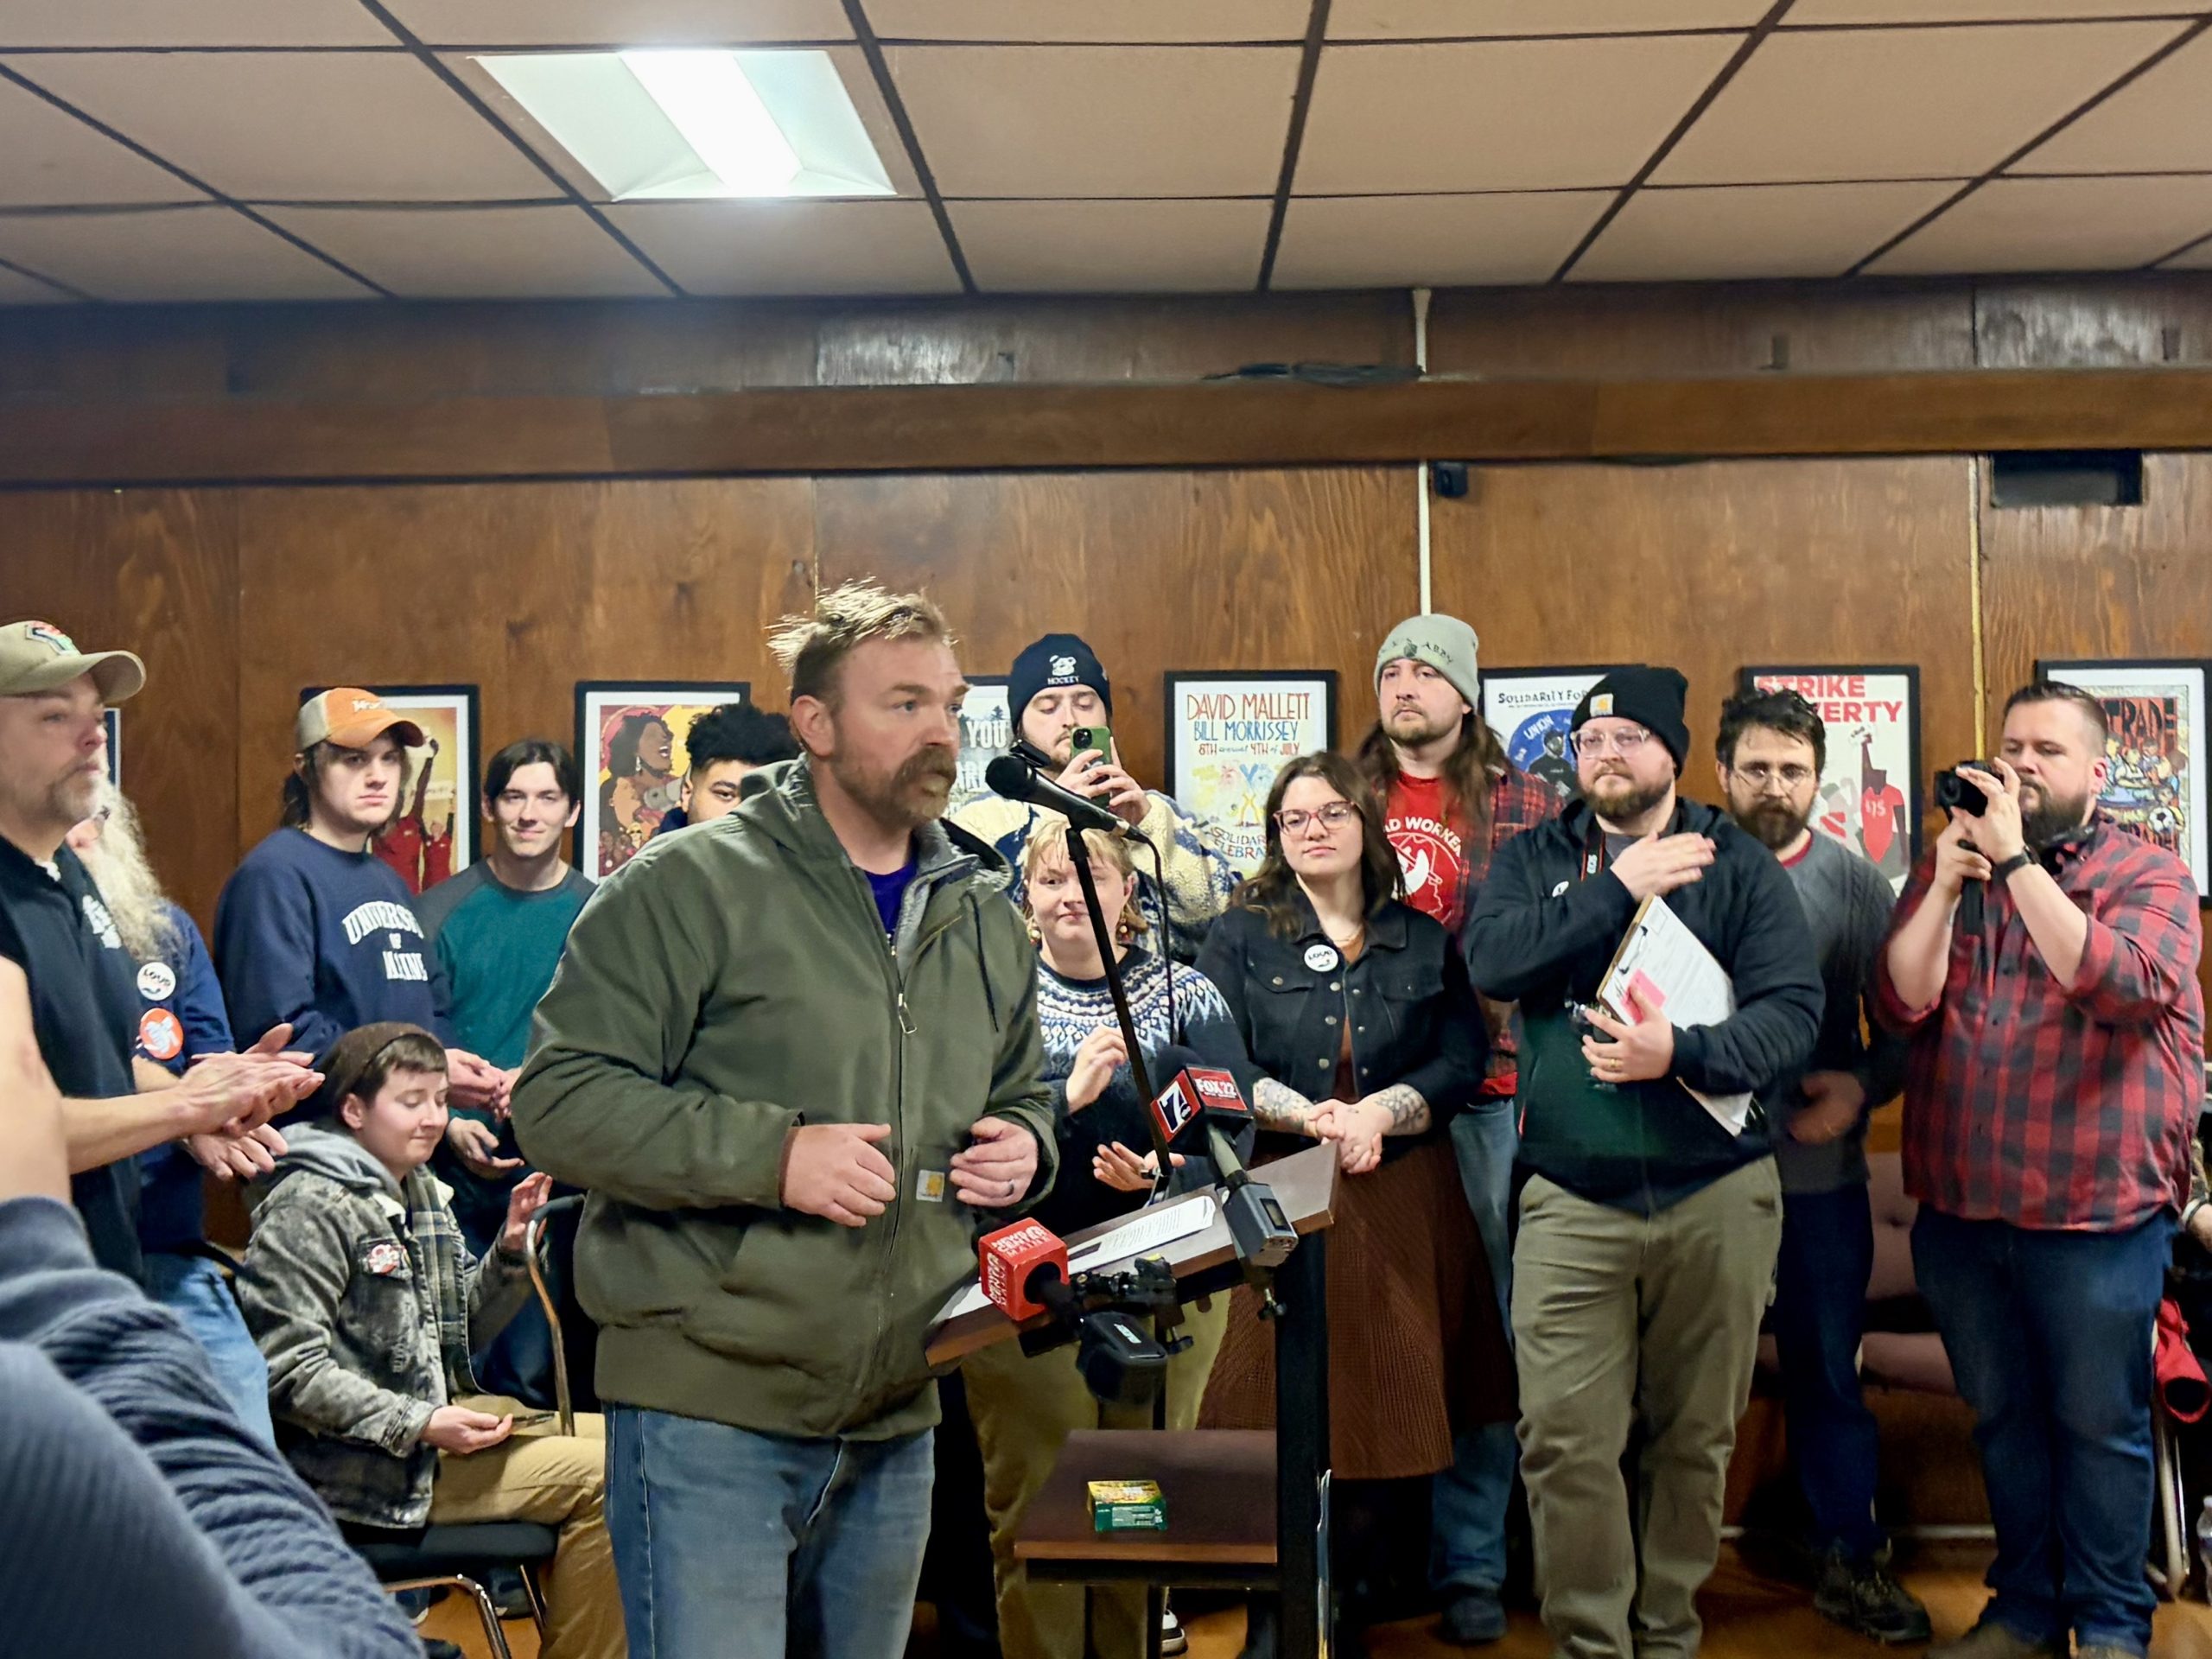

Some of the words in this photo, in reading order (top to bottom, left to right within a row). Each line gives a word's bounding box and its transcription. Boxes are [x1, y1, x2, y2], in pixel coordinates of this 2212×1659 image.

[1047, 676, 1079, 685] HOCKEY
[1758, 676, 1866, 698] STRIKE
[1187, 694, 1236, 720] DAVID
[1243, 693, 1310, 720] MALLETT
[966, 721, 1007, 748] YOU
[1194, 721, 1218, 741] BILL
[1224, 721, 1299, 741] MORRISSEY
[1523, 714, 1554, 741] UNION
[1250, 743, 1268, 754] 4TH
[1280, 742, 1300, 755] JULY
